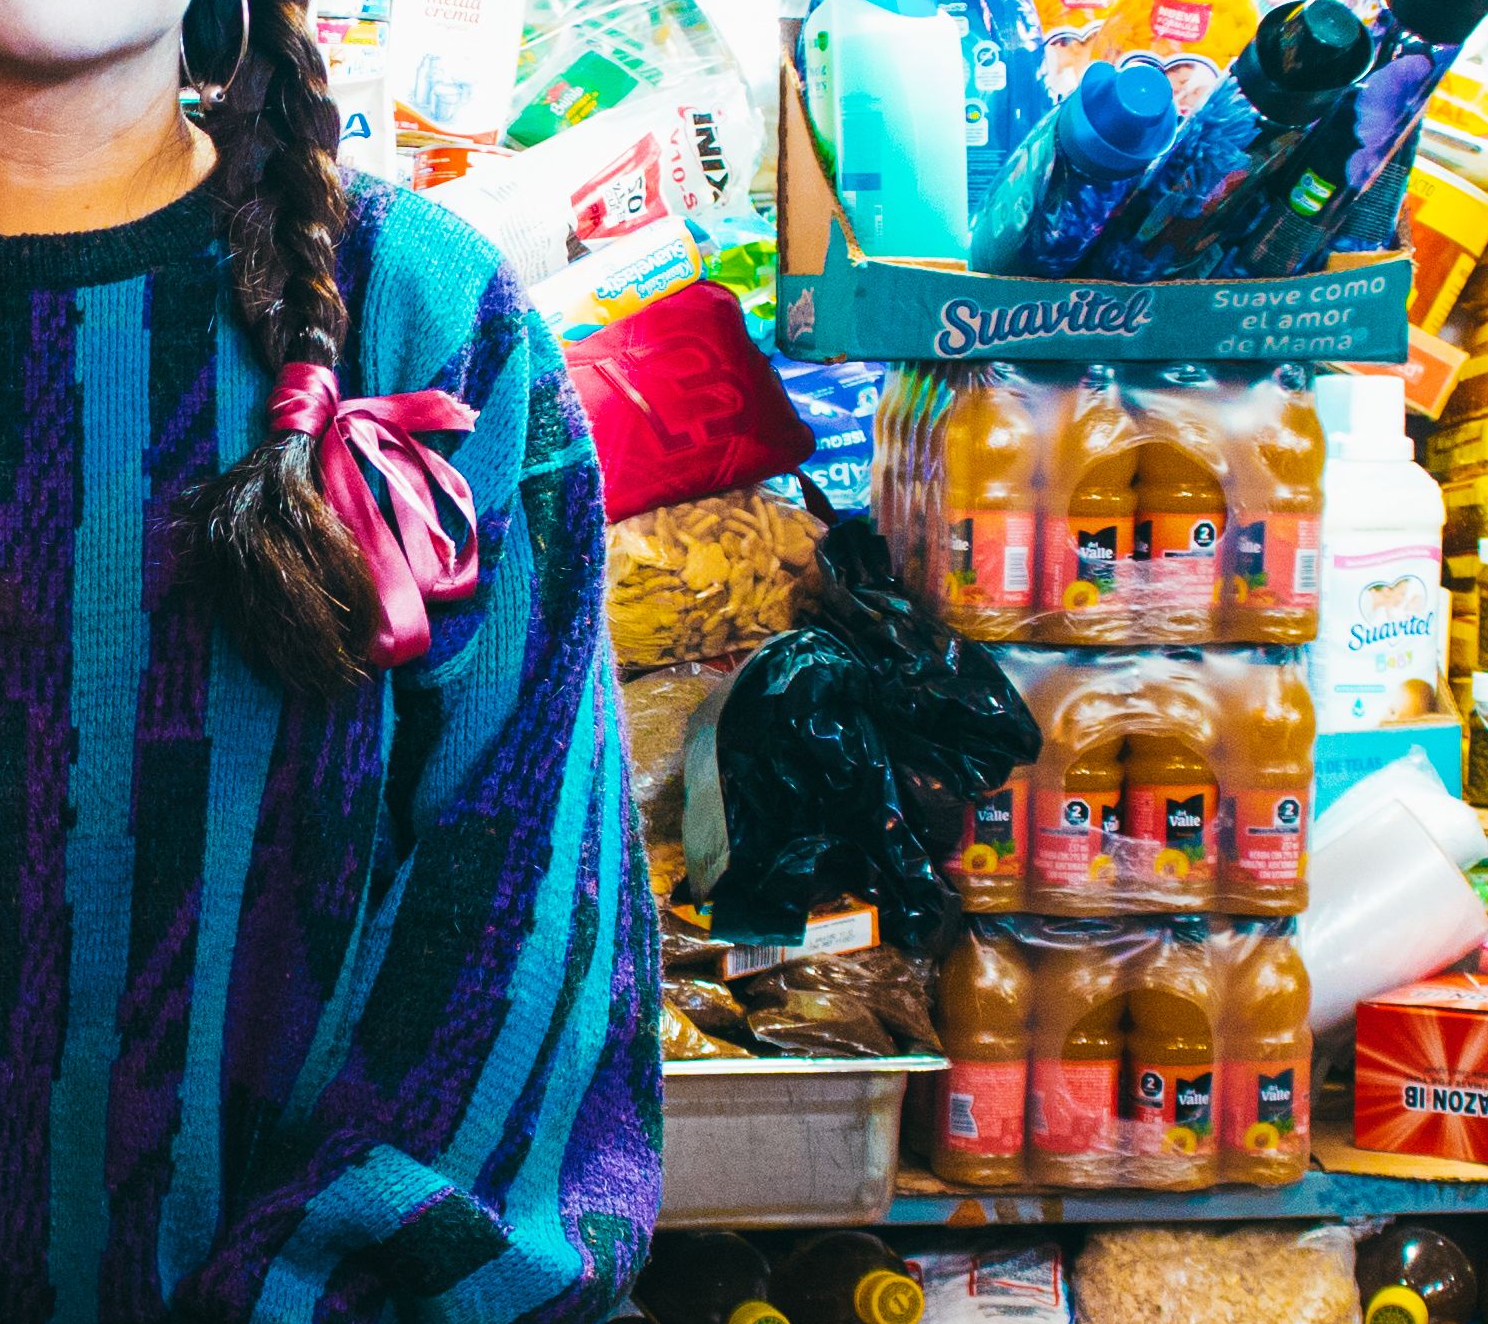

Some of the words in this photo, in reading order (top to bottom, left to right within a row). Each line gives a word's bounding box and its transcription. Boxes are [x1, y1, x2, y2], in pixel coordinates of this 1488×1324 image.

[424, 6, 480, 25] crema
[1213, 284, 1300, 311] Suave
[1308, 277, 1386, 306] como
[933, 287, 1154, 359] Suavitel
[1242, 308, 1270, 330] el
[1278, 305, 1352, 331] amor
[1219, 333, 1254, 356] de
[1076, 543, 1114, 561] Valle
[1348, 613, 1434, 651] Suavitel
[977, 808, 1012, 825] Valle
[1168, 810, 1201, 828] Valle
[1175, 1090, 1209, 1108] Valle
[1260, 1086, 1292, 1103] Valle
